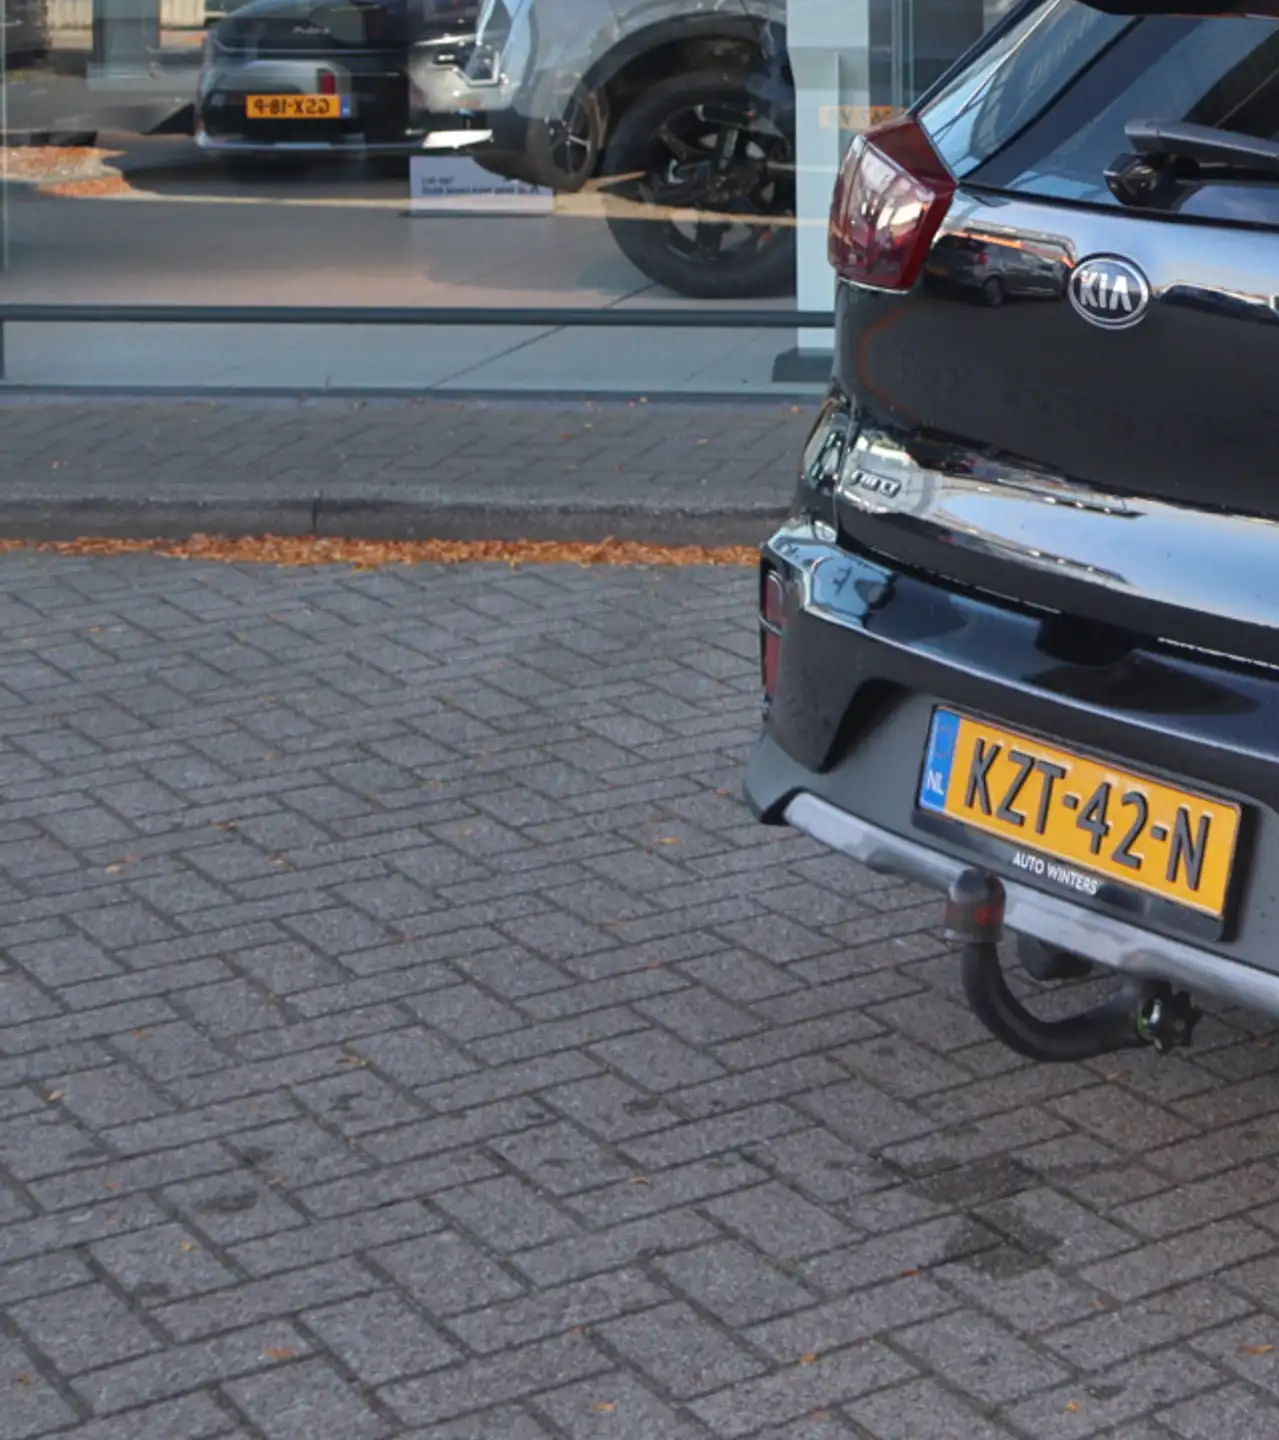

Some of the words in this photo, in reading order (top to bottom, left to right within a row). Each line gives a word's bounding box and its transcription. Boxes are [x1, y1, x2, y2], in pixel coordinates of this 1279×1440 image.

[1080, 270, 1132, 312] KIA
[925, 769, 945, 796] NL
[964, 737, 1211, 891] KZT-42-N
[1012, 851, 1044, 875] AUTO
[1047, 864, 1100, 897] WINTERS
